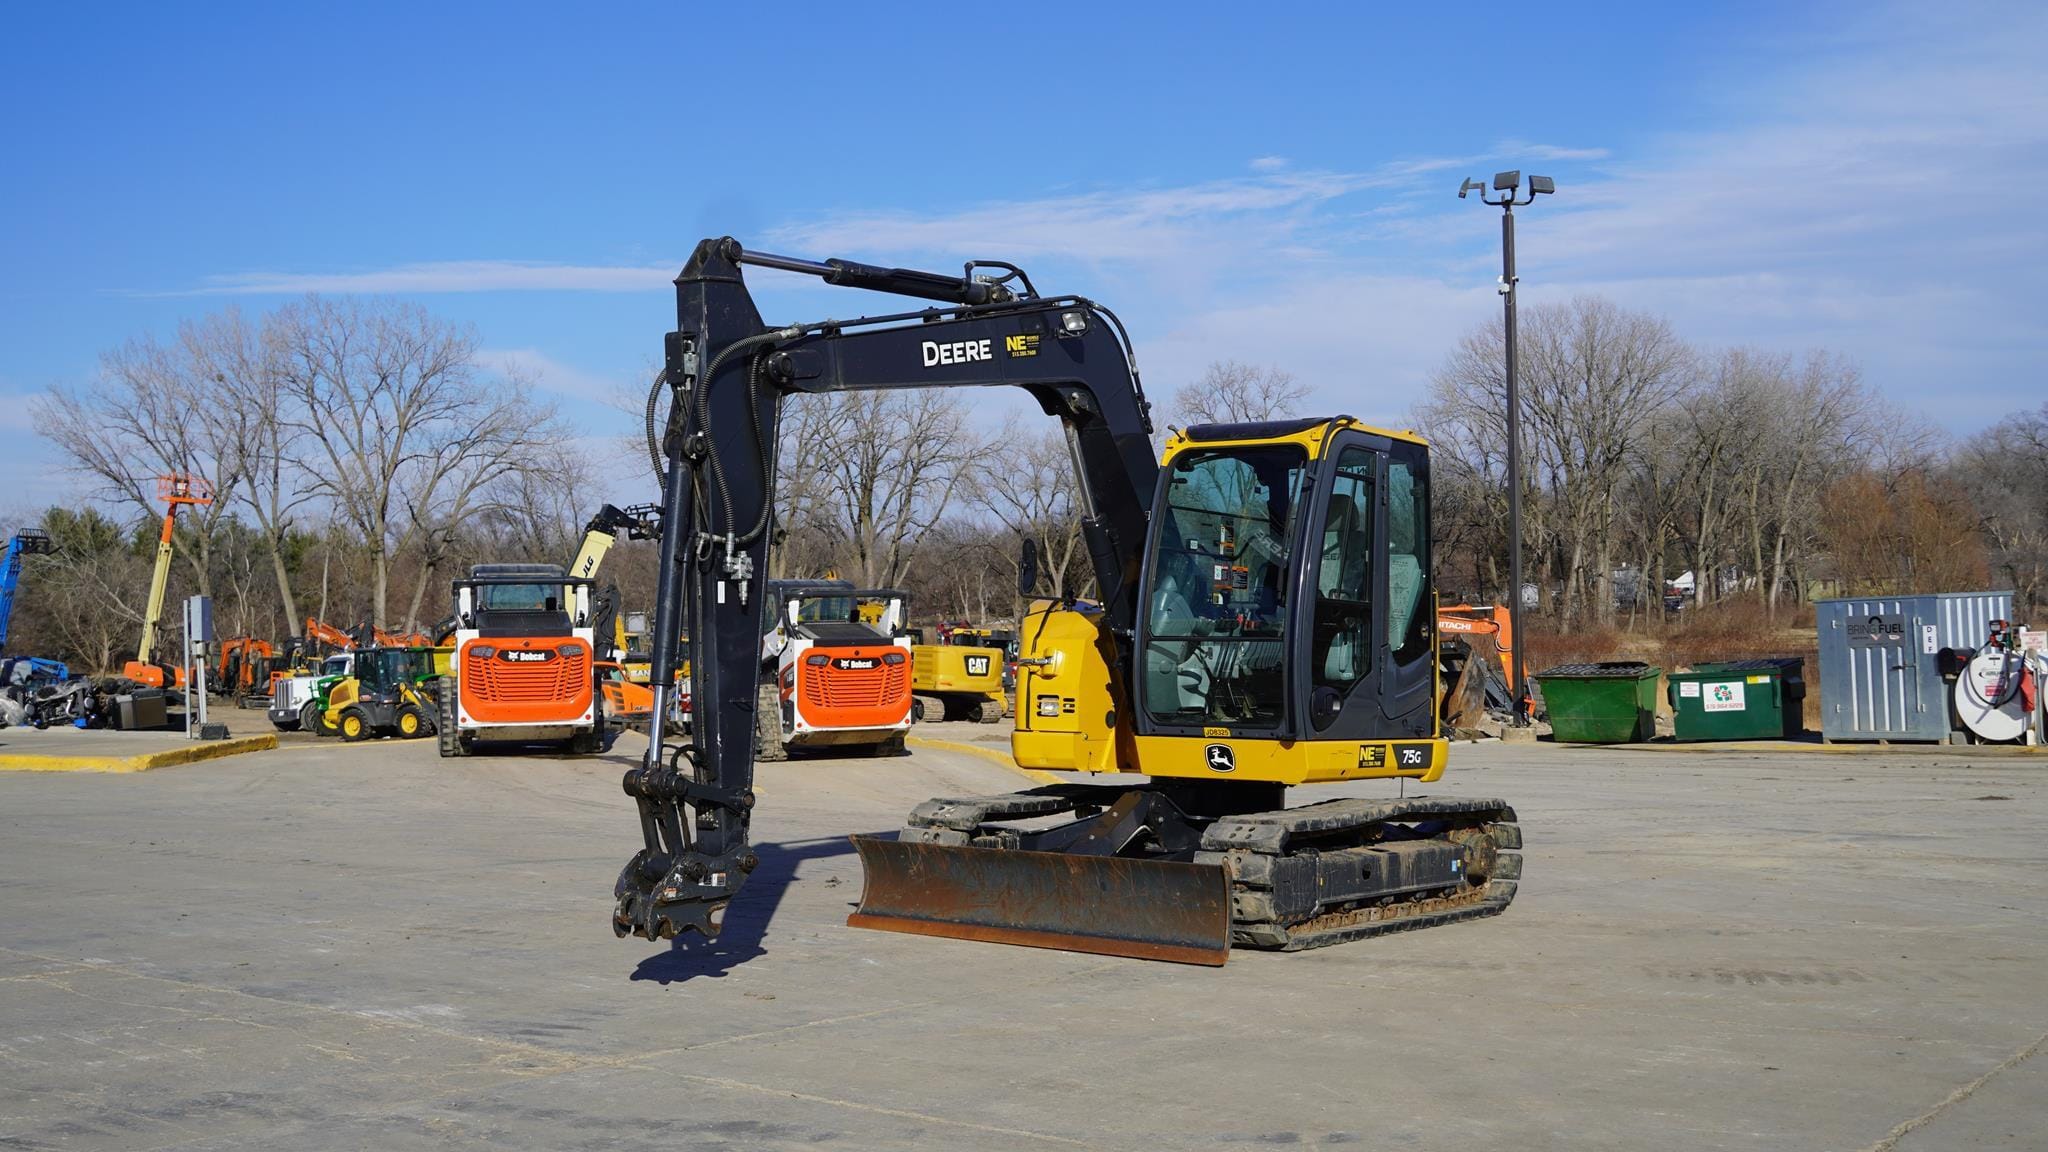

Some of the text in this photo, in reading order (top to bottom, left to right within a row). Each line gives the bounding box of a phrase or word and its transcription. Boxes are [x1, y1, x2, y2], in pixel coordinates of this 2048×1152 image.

[1006, 335, 1027, 351] NE
[922, 339, 992, 367] DEERE
[582, 556, 595, 577] JLG
[1847, 623, 1904, 635] BRING FUEL
[519, 652, 545, 661] Bobcat
[850, 660, 873, 669] Bobcat
[968, 657, 988, 674] CAT
[1360, 747, 1376, 761] NE
[1402, 749, 1422, 764] 75G
